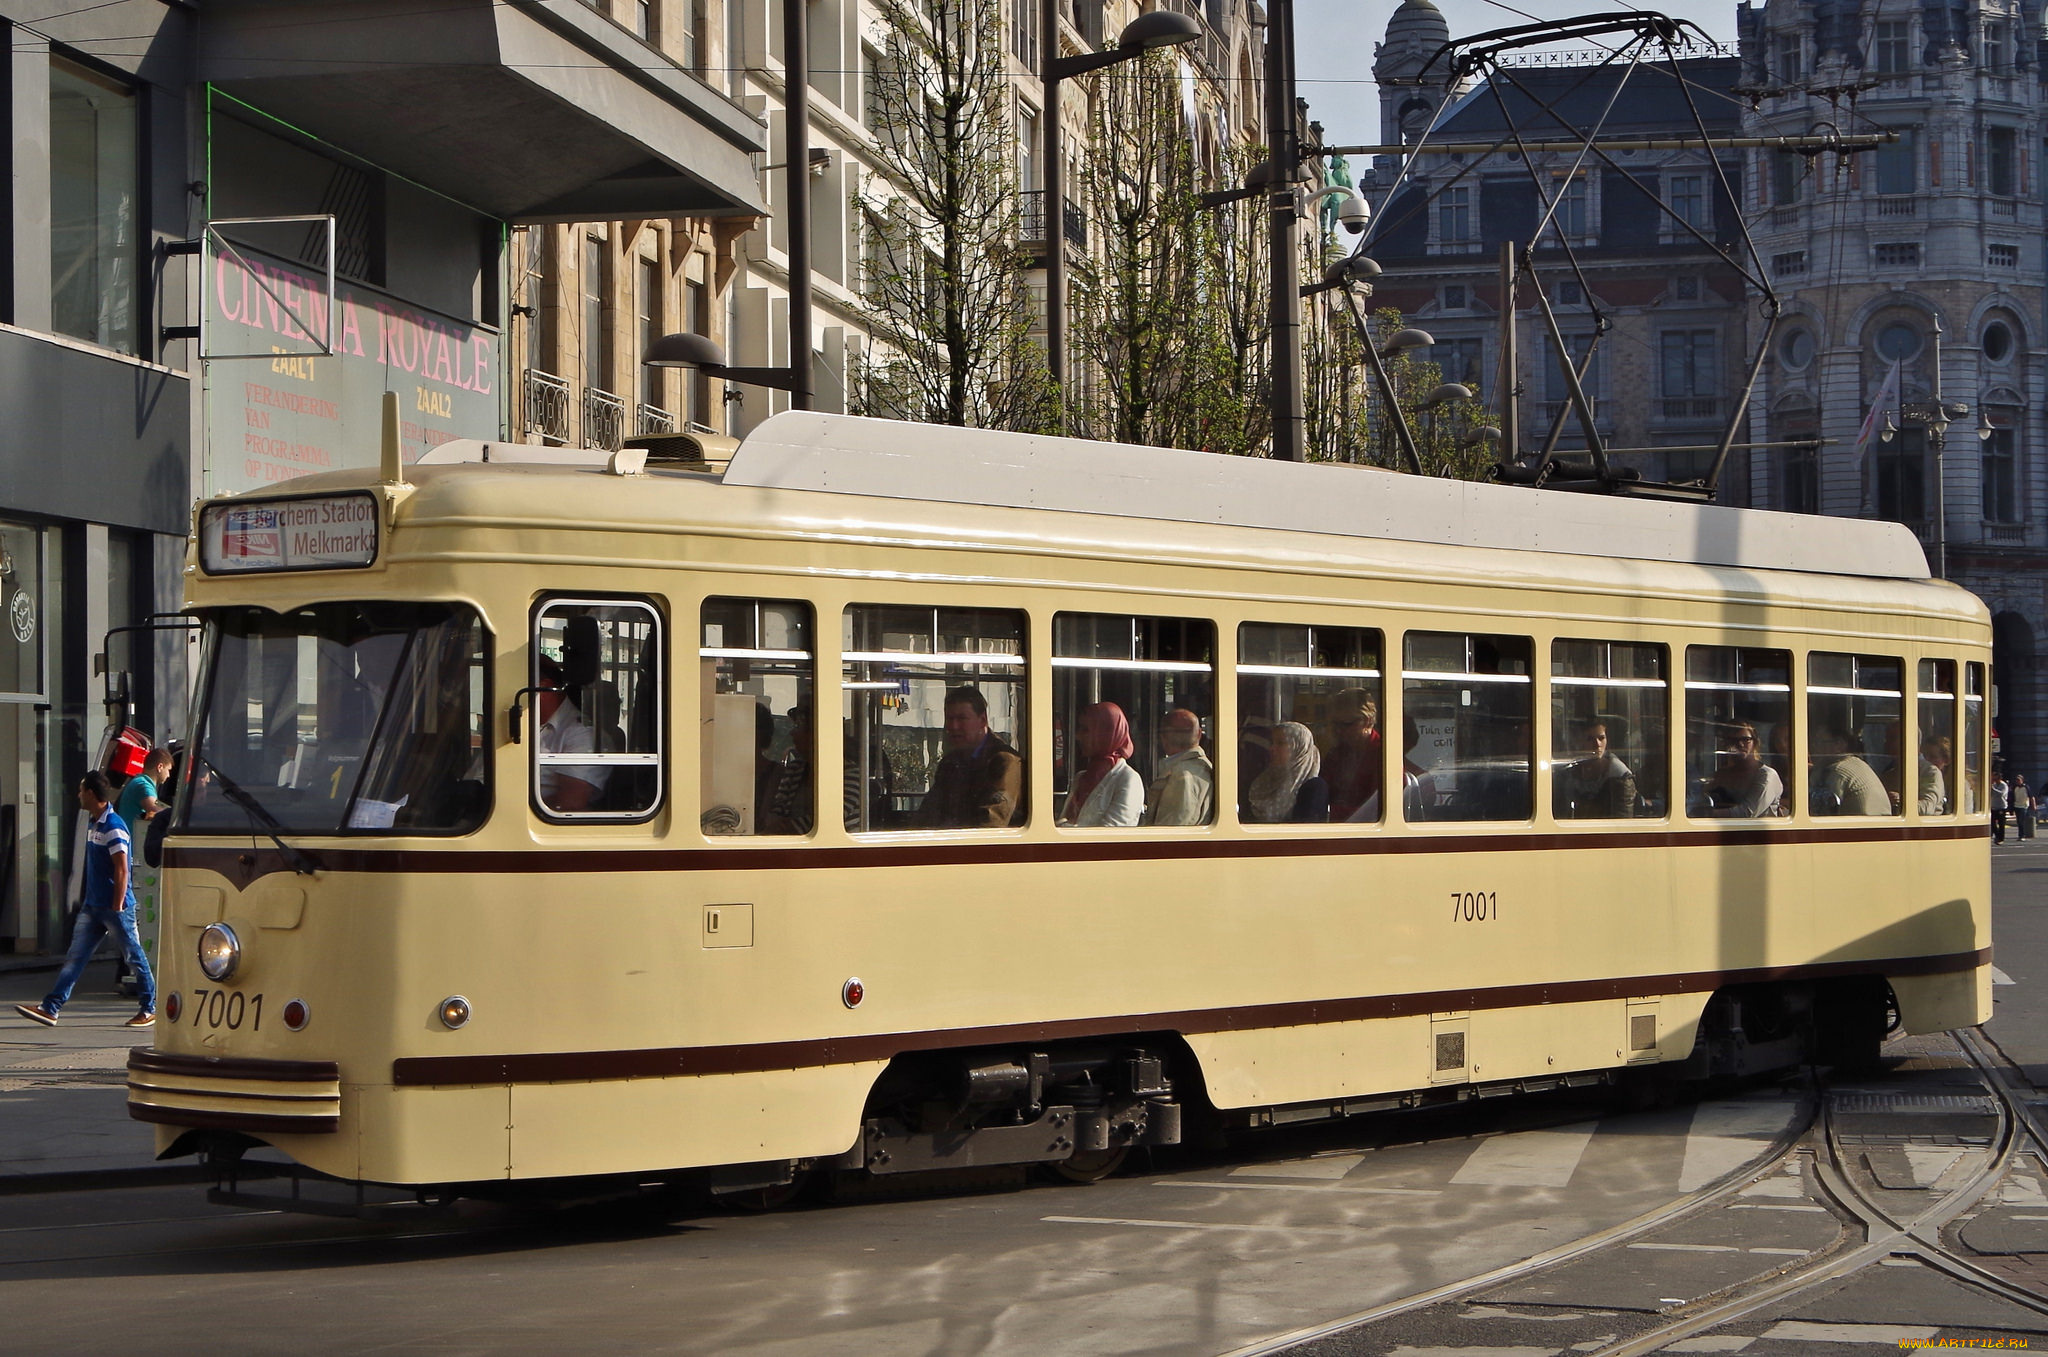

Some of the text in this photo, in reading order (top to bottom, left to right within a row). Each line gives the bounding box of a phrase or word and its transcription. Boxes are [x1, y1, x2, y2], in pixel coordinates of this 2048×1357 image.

[216, 250, 491, 395] CINEMA ROYALE
[244, 382, 340, 421] VERANDERING
[244, 407, 271, 429] VAN
[244, 432, 332, 467] PROGRAMMA
[400, 443, 417, 462] AN
[245, 458, 319, 482] OP DOND
[321, 500, 375, 523] Station
[294, 527, 375, 556] Melkmarkt
[1451, 891, 1496, 923] 7001
[193, 989, 263, 1031] 7001
